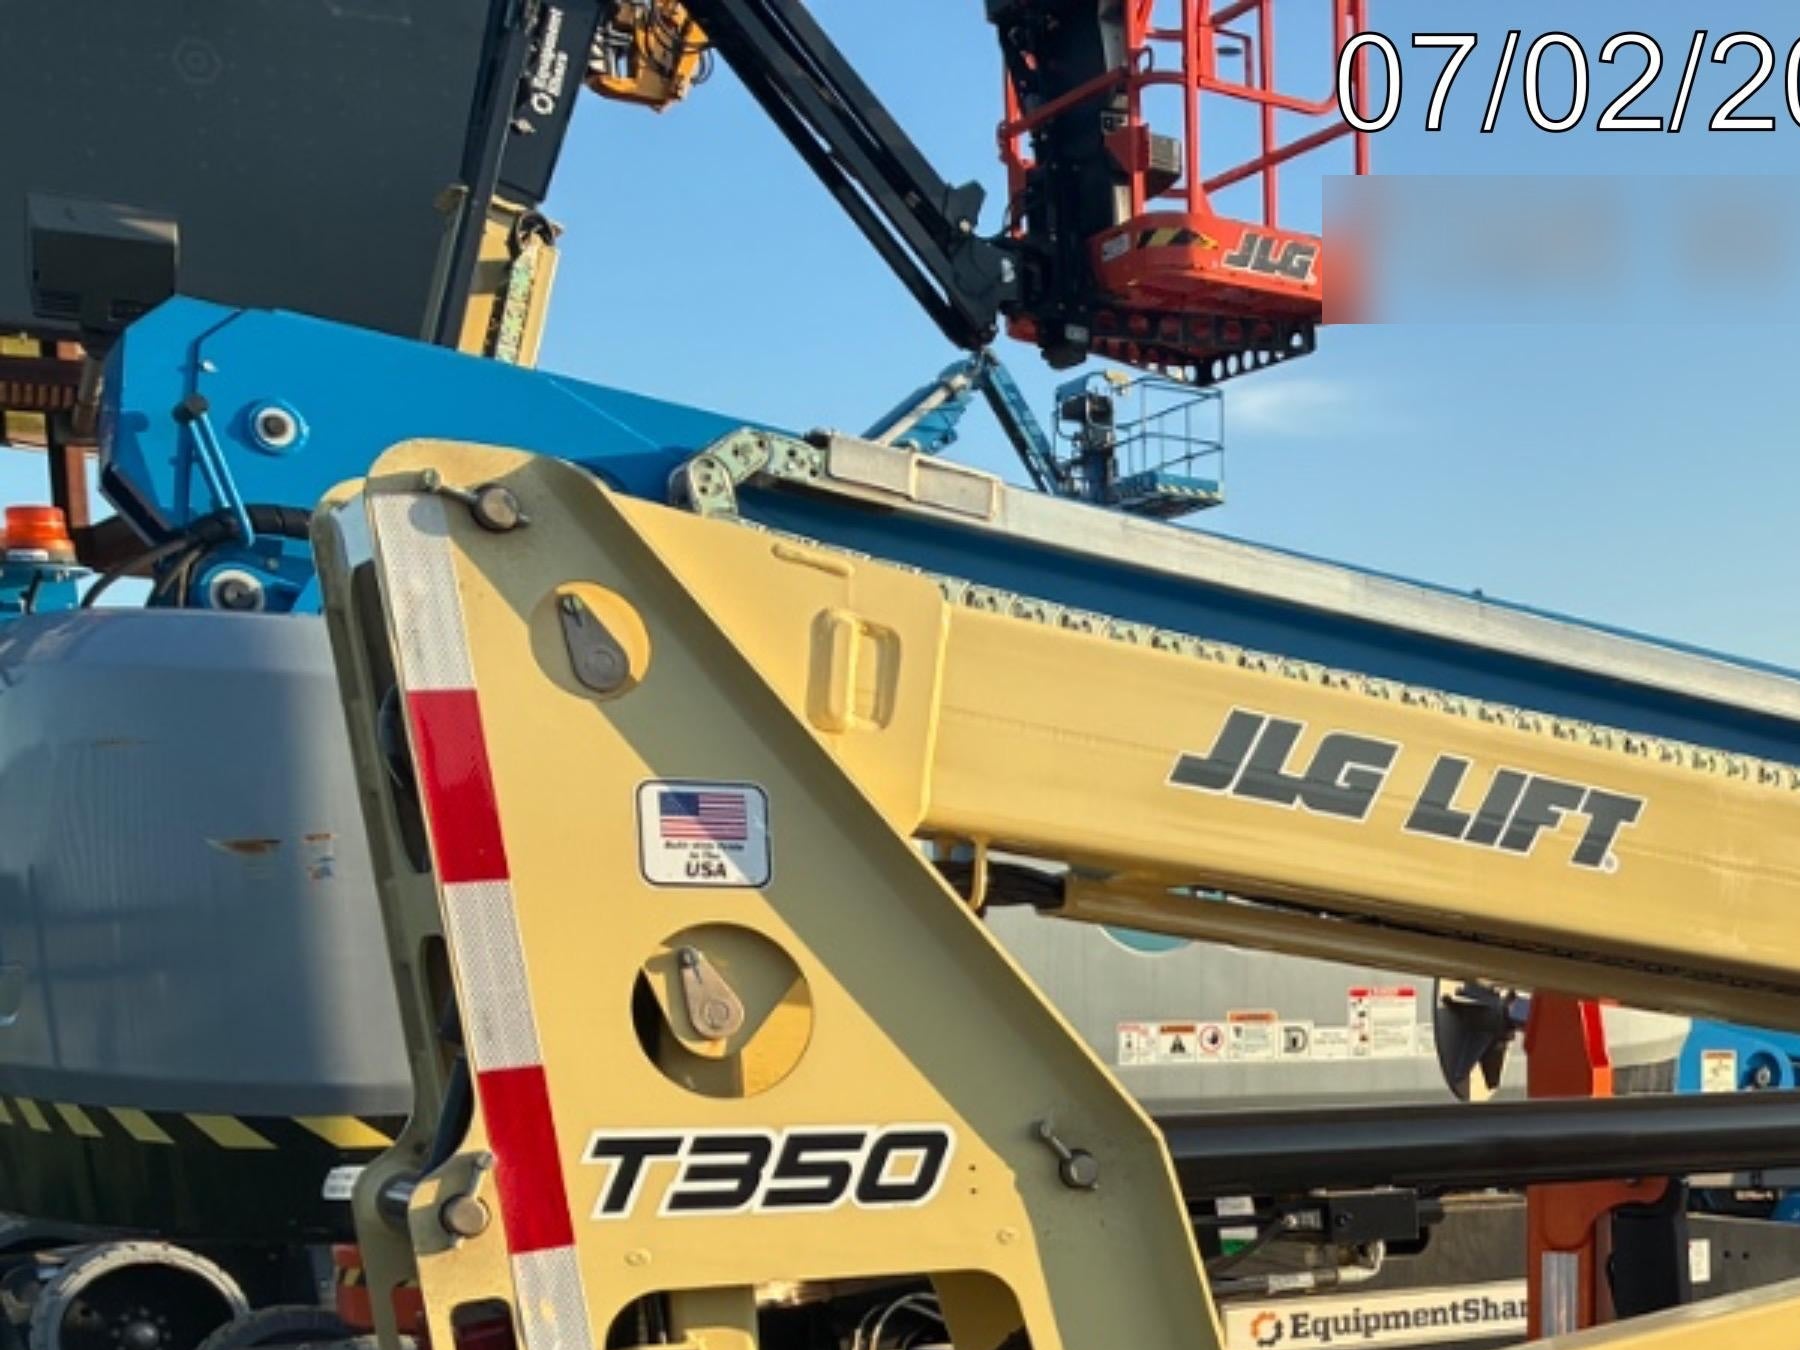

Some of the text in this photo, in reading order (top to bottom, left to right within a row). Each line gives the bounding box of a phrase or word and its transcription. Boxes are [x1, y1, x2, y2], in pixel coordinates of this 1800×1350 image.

[1222, 228, 1318, 282] JLG
[1166, 706, 1648, 871] JLG LIFT
[685, 860, 728, 878] USA
[586, 1125, 955, 1217] T350
[1290, 1297, 1527, 1341] EquipmentShar
